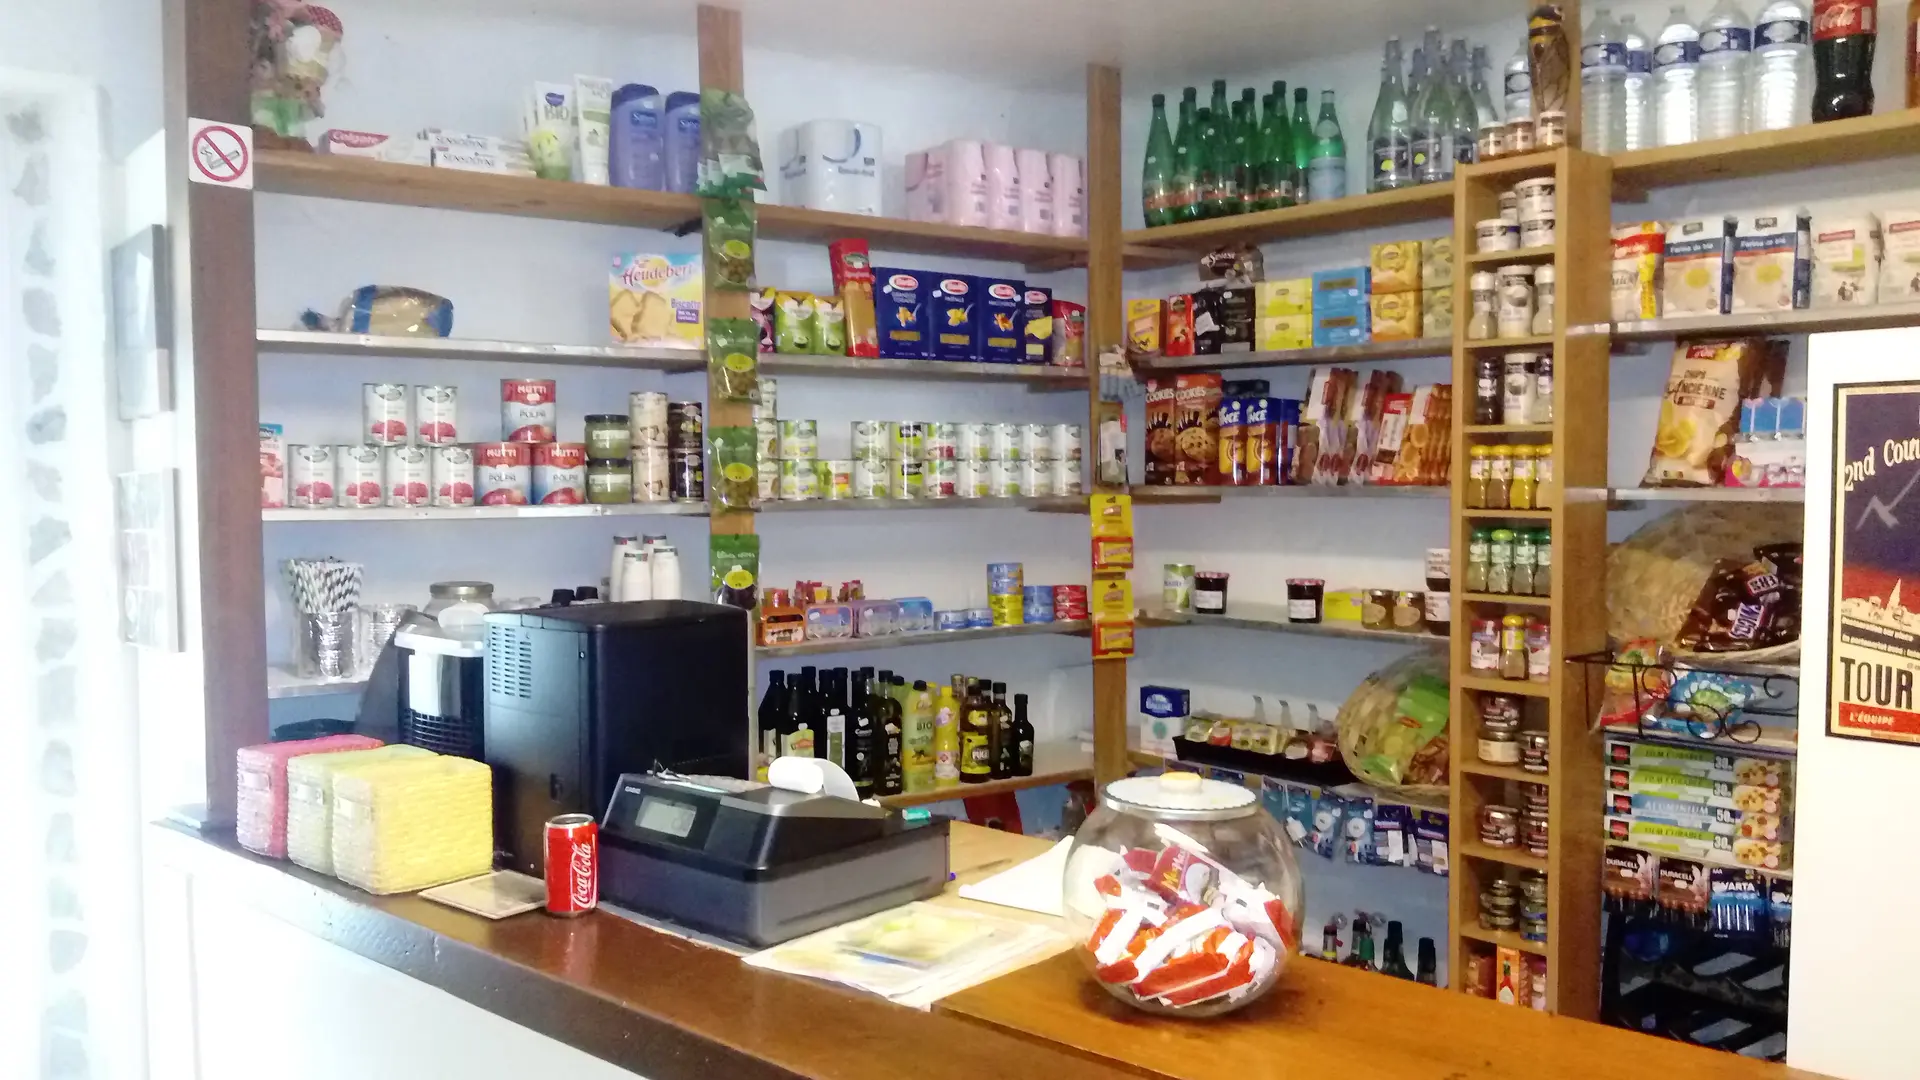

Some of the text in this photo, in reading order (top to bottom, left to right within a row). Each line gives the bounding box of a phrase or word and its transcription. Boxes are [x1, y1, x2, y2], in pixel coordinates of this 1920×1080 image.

[332, 130, 379, 146] Colgate
[442, 153, 496, 168] SENSODYNE
[621, 262, 693, 287] Heudebert
[517, 384, 547, 394] MUTTI
[1145, 387, 1175, 404] COOKIES
[1175, 386, 1207, 402] COOKIES
[519, 408, 547, 419] POLPA
[487, 448, 517, 458] MUTTI
[551, 448, 579, 458] MUTTI
[1844, 446, 1876, 492] 2nd
[489, 473, 517, 482] POLPA
[553, 473, 579, 482] POLPA
[1840, 656, 1913, 710] TOUR
[1645, 801, 1709, 816] ALUMINIUM
[1605, 857, 1638, 869] DURACELL
[571, 841, 592, 909] Coca-Cola
[1659, 869, 1693, 881] DURACELL
[1720, 880, 1756, 892] VARTA
